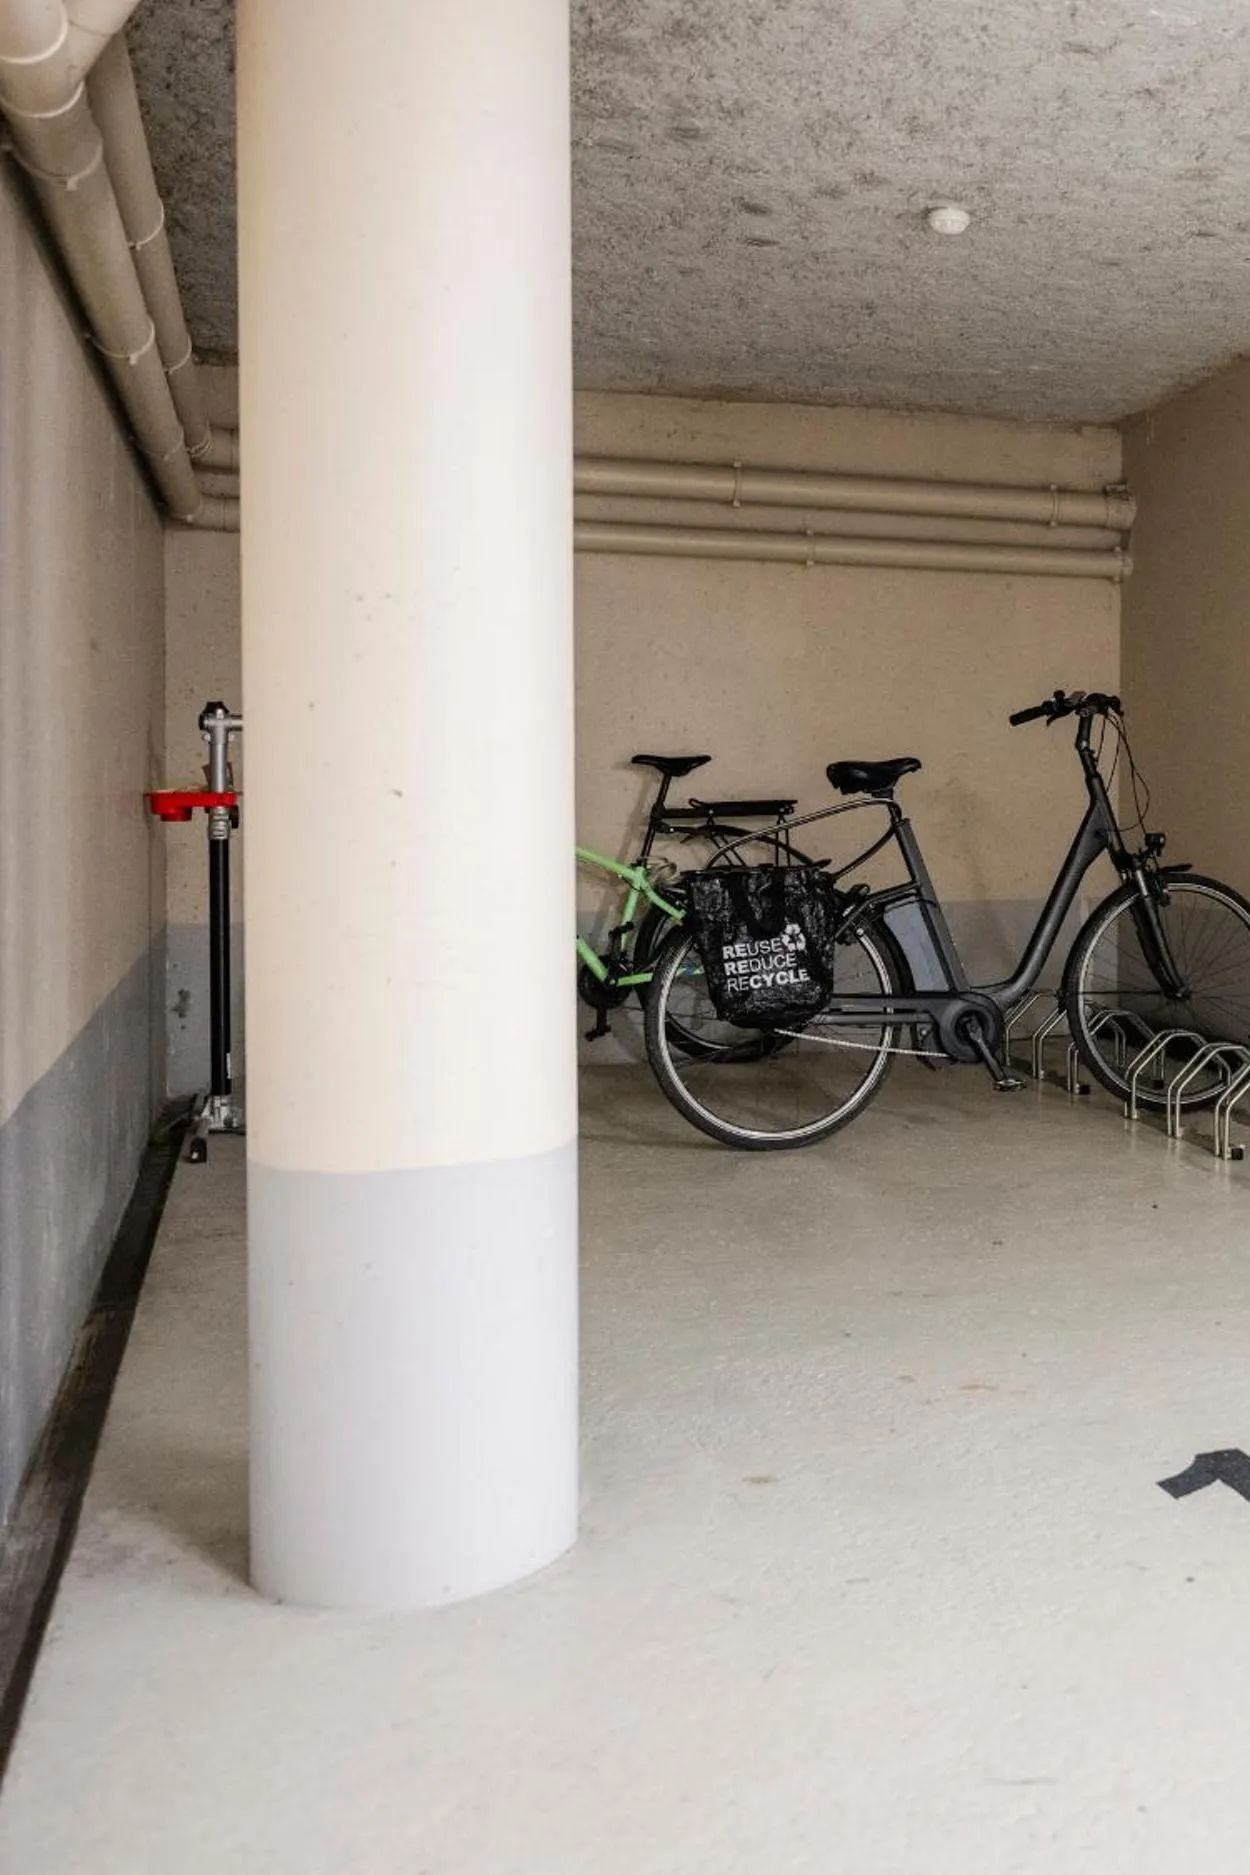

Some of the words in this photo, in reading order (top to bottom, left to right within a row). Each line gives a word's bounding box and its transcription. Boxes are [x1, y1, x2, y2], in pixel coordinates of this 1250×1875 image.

[722, 938, 783, 959] REUSE
[723, 953, 797, 976] REDUCE
[727, 968, 811, 992] RECYCLE
